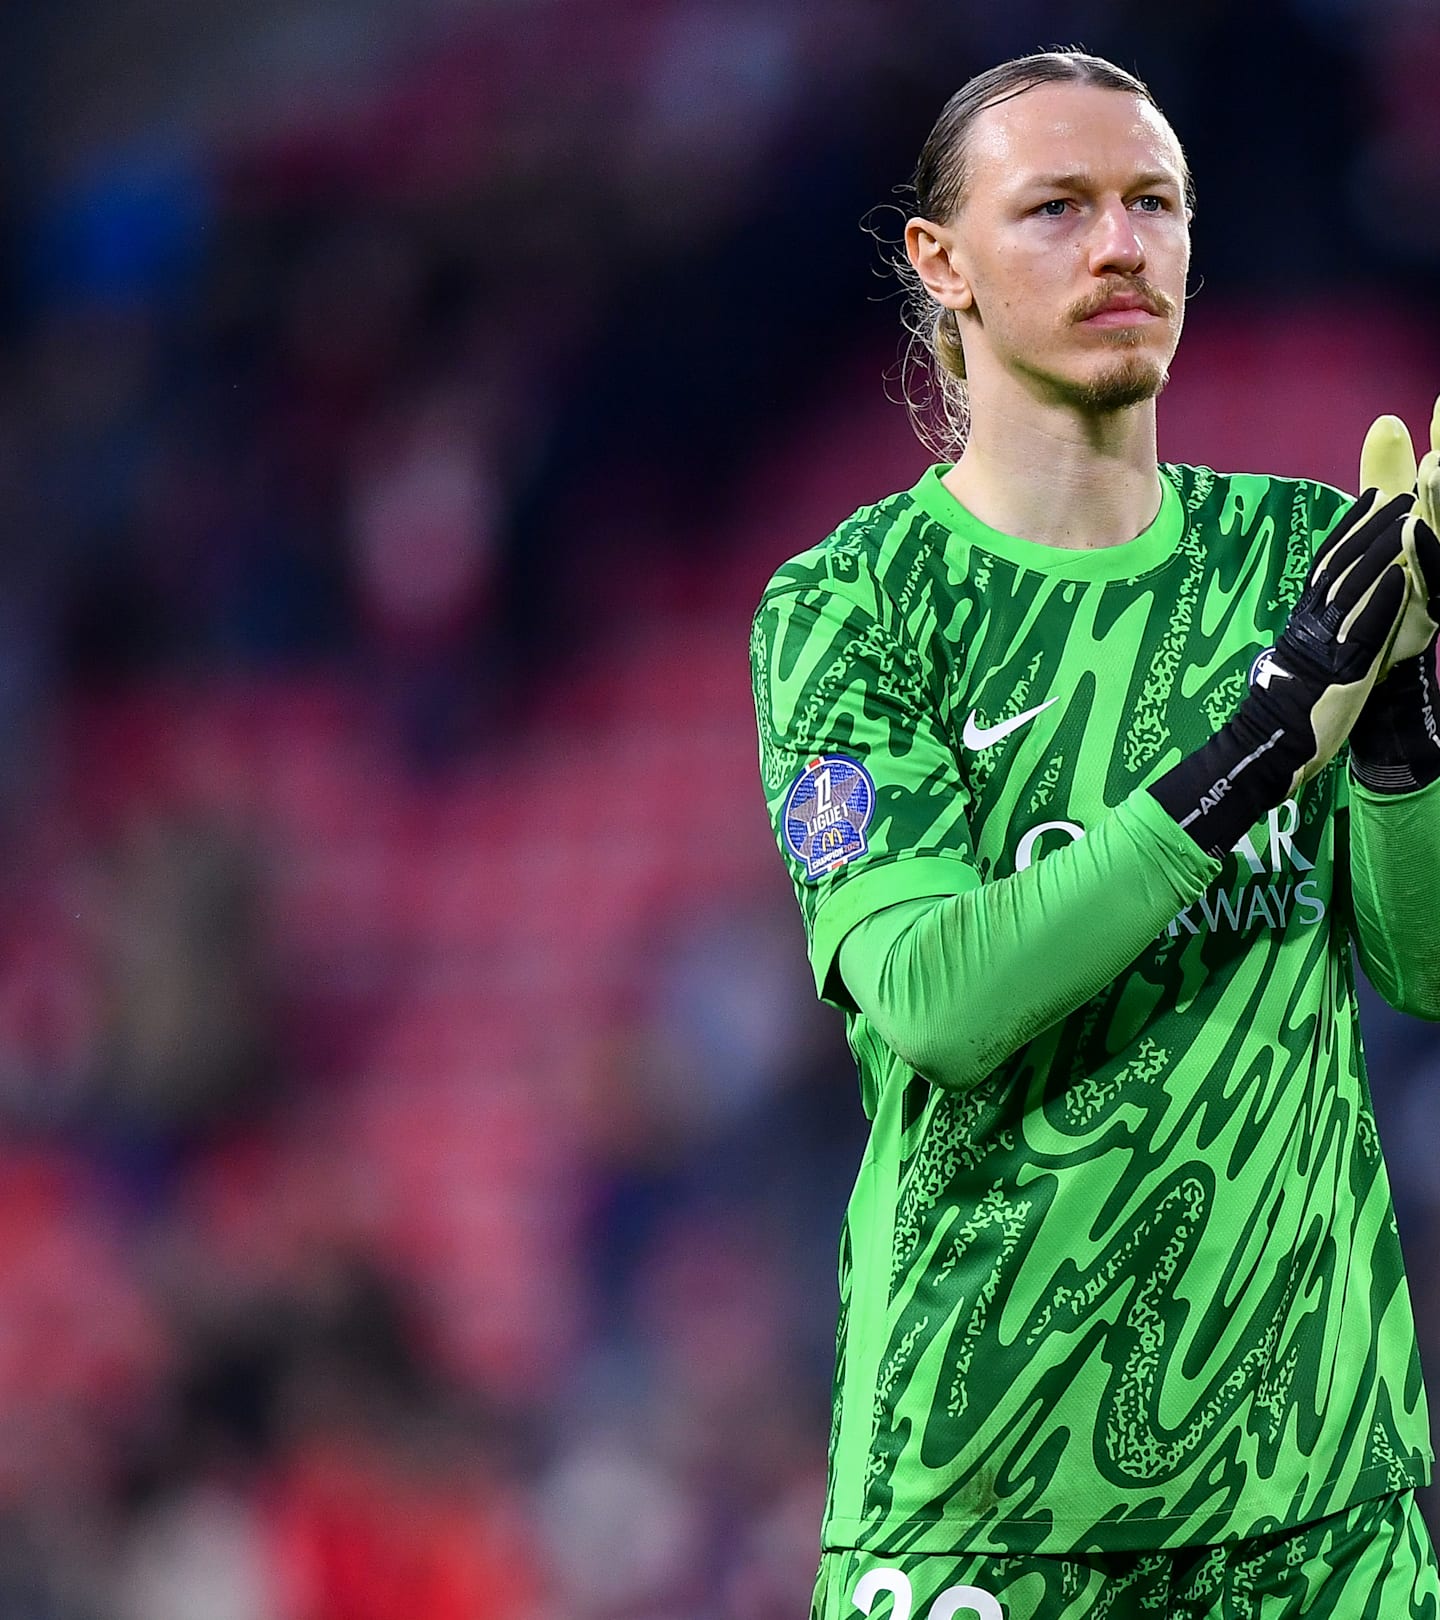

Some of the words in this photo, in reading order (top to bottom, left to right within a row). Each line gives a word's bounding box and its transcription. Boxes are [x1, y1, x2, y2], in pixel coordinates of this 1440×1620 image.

[1422, 705, 1437, 739] AIR
[1200, 778, 1232, 815] AIR
[1156, 880, 1326, 938] WAYS
